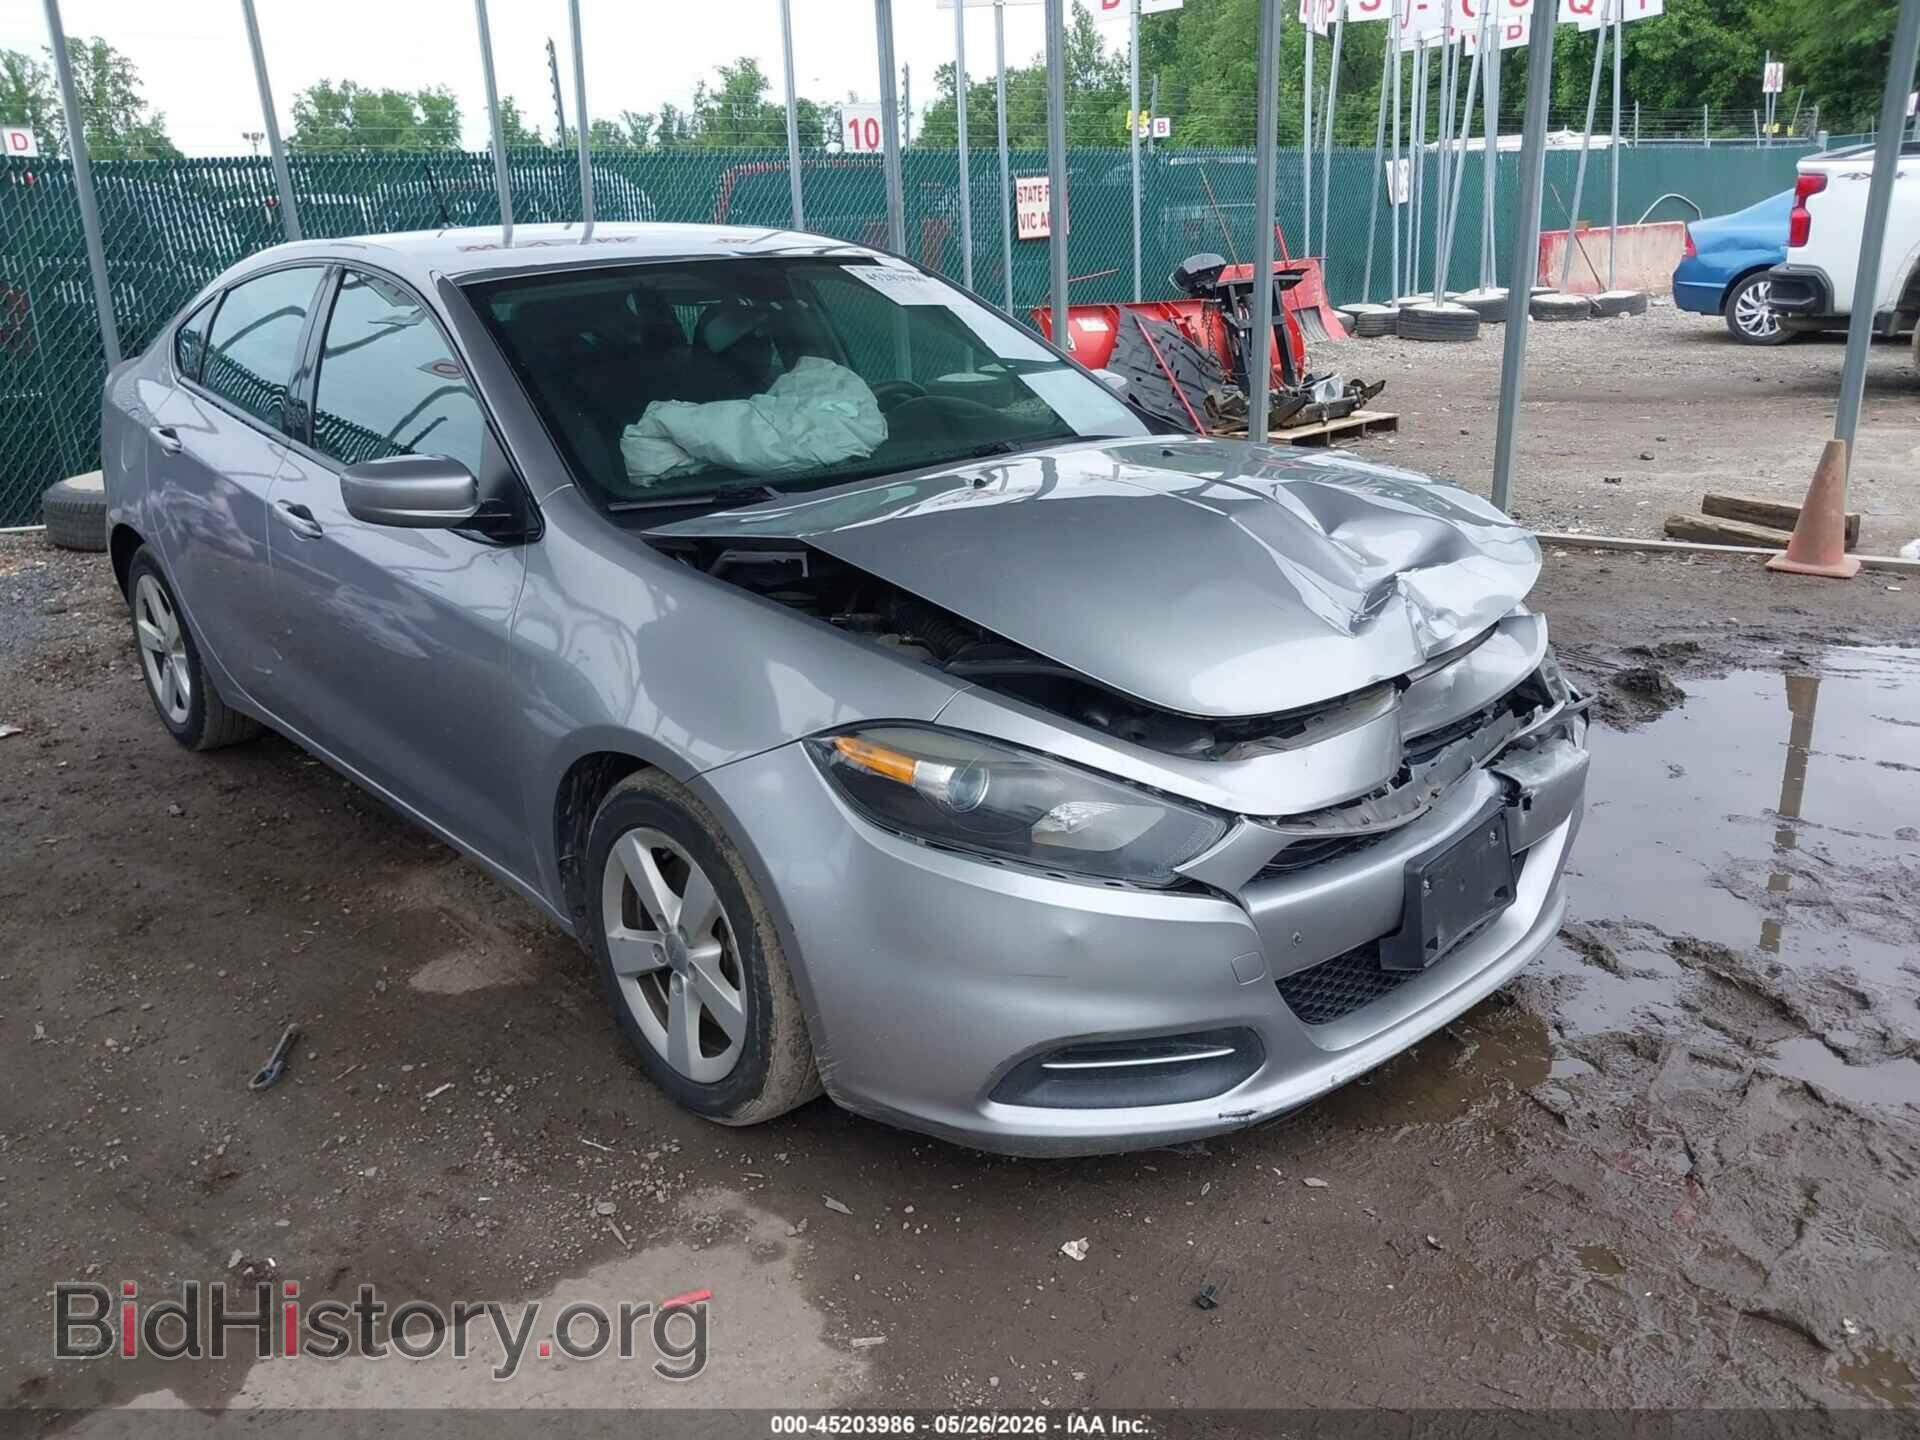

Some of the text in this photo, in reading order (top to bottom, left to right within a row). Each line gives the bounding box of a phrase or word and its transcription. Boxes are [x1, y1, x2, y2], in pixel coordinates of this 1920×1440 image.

[11, 132, 28, 151] D
[848, 117, 880, 150] 10
[1018, 185, 1043, 204] STATE
[1019, 212, 1037, 231] VIC
